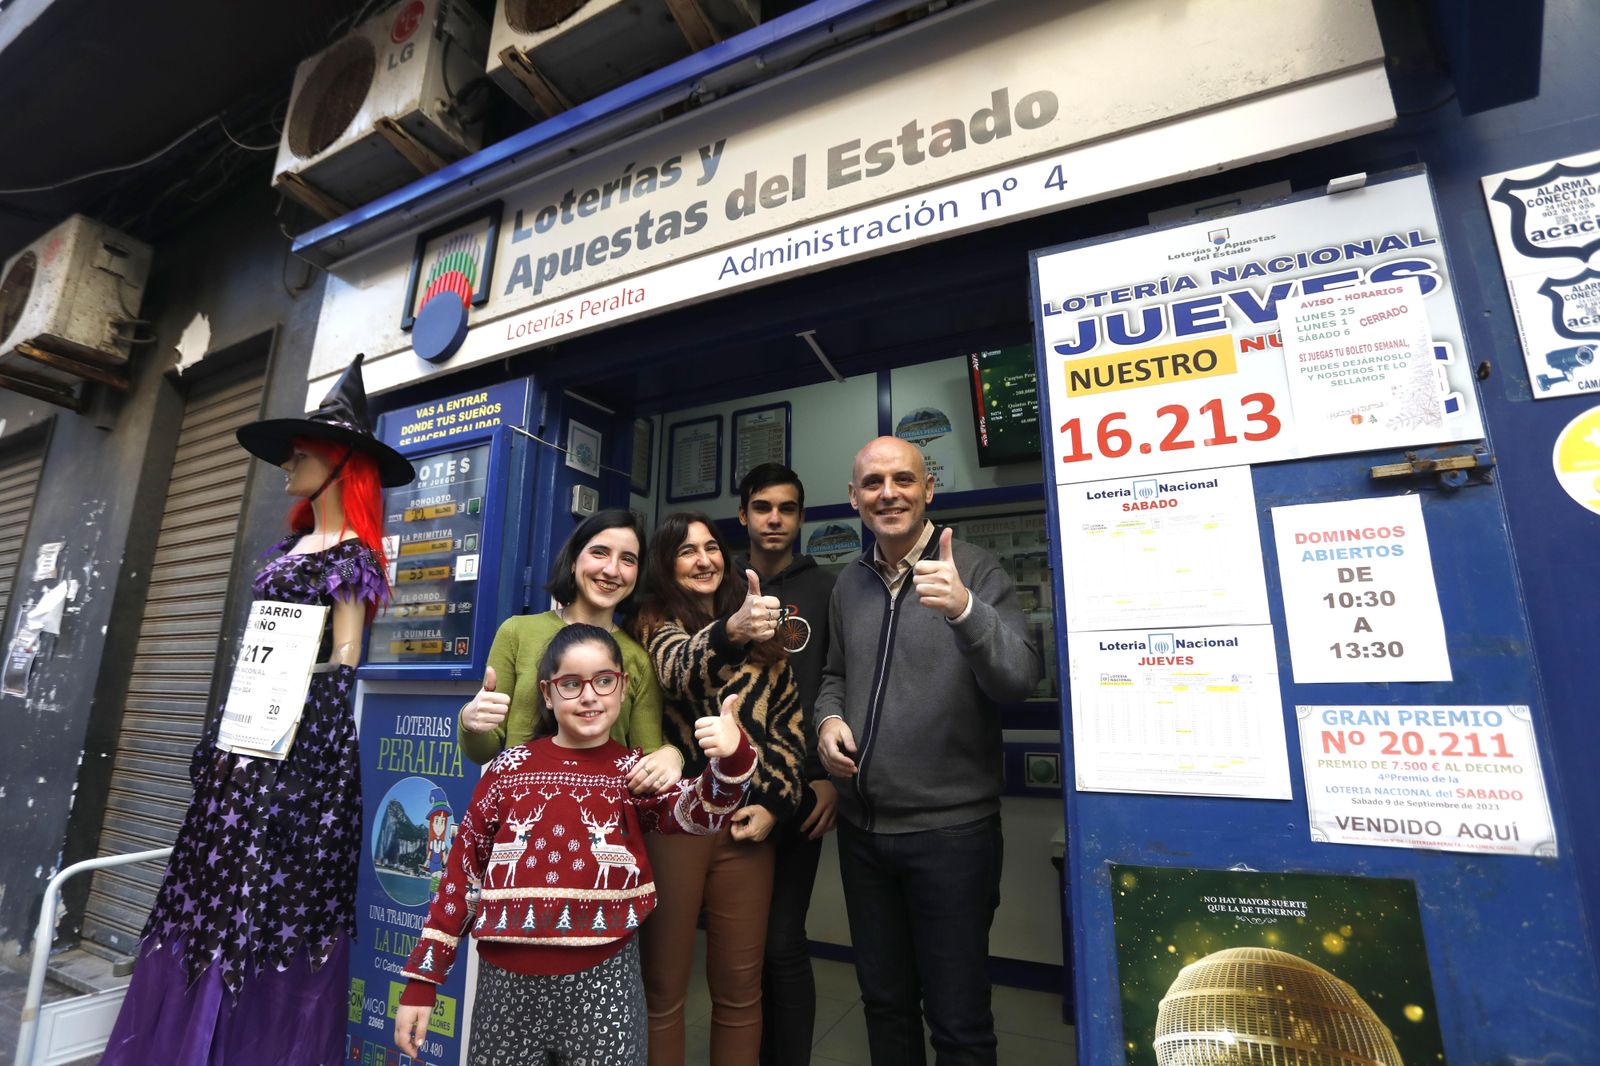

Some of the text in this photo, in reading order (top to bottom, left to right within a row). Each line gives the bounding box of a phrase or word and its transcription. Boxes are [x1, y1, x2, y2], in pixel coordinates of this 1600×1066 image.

[388, 42, 415, 71] LG
[503, 87, 1060, 296] Apuestas del Estado
[510, 138, 727, 245] Loterías y
[1537, 178, 1591, 197] ALARMA
[1527, 185, 1600, 209] CONECTAD
[718, 196, 959, 281] Administración
[1043, 164, 1069, 192] 4
[1168, 248, 1212, 260] Loterías
[1224, 234, 1277, 249] Apuestas
[1194, 247, 1251, 262] del Estado
[1043, 230, 1436, 317] LOTERÍA NACIONAL
[1572, 281, 1600, 293] ALAR
[1300, 297, 1334, 309] AVISO
[1345, 287, 1403, 301] HORARIOS
[507, 286, 646, 341] Loterías Peralta
[1295, 307, 1355, 323] LUNES 25
[1359, 305, 1408, 327] CERRADO
[1297, 320, 1337, 332] LUNES
[1298, 330, 1340, 342] SÁBADO
[1299, 353, 1307, 362] SI
[1308, 349, 1333, 362] JUEGAS
[1335, 348, 1344, 357] TU
[1346, 344, 1373, 355] BOLETO
[1070, 348, 1218, 392] NUESTRO
[1300, 352, 1412, 373] PUEDES DEJÁRNOSLO
[1317, 366, 1374, 380] NOSOTROS
[1393, 361, 1407, 369] LO
[1330, 374, 1386, 387] SELLAMOS
[416, 392, 488, 418] VAS A ENTRAR
[401, 403, 502, 436] DONDE TUS SUEÑOS
[1060, 392, 1282, 463] 16.213
[419, 457, 470, 481] OTES
[1087, 479, 1218, 500] Loteria Nacional
[410, 494, 451, 507] BONOLOTO
[1122, 498, 1178, 512] SABADO
[413, 529, 453, 541] PRIMITIVA
[1295, 526, 1406, 545] DOMINGOS
[1301, 544, 1404, 562] ABIERTOS
[1337, 566, 1373, 583] DE
[413, 592, 440, 601] GORDO
[1323, 590, 1396, 609] 10:30
[1353, 617, 1373, 633] A
[404, 630, 441, 639] QUINIELA
[1099, 637, 1238, 651] Loteria Nacional
[1330, 641, 1404, 659] 13:30
[1138, 656, 1194, 666] JUEVES
[269, 704, 280, 715] 20
[1322, 709, 1503, 727] GRAN PREMIO
[395, 715, 451, 738] LOTERIAS
[1379, 731, 1514, 758] 20.211
[376, 738, 464, 778] PERALTA
[1317, 759, 1523, 774] PREMIO DE 7.500 € AL DECIMO
[1432, 774, 1445, 784] de
[1449, 774, 1459, 784] la
[1326, 785, 1523, 801] LOTERIA NACIONAL del SABADO
[1386, 799, 1391, 807] 9
[1393, 799, 1404, 807] de
[1406, 799, 1460, 810] Septiembre
[1476, 802, 1500, 811] 2023
[1335, 815, 1519, 841] VENDIDO AQUÍ
[1207, 904, 1226, 913] QUE
[1255, 907, 1306, 917] TENERNOS
[1219, 896, 1236, 904] HAY
[1239, 897, 1270, 906] MAYOR
[1272, 900, 1307, 909] SUERTE
[370, 905, 428, 930] UNA TRADICIO
[374, 928, 419, 957] LA LIN
[430, 1042, 444, 1058] 480
